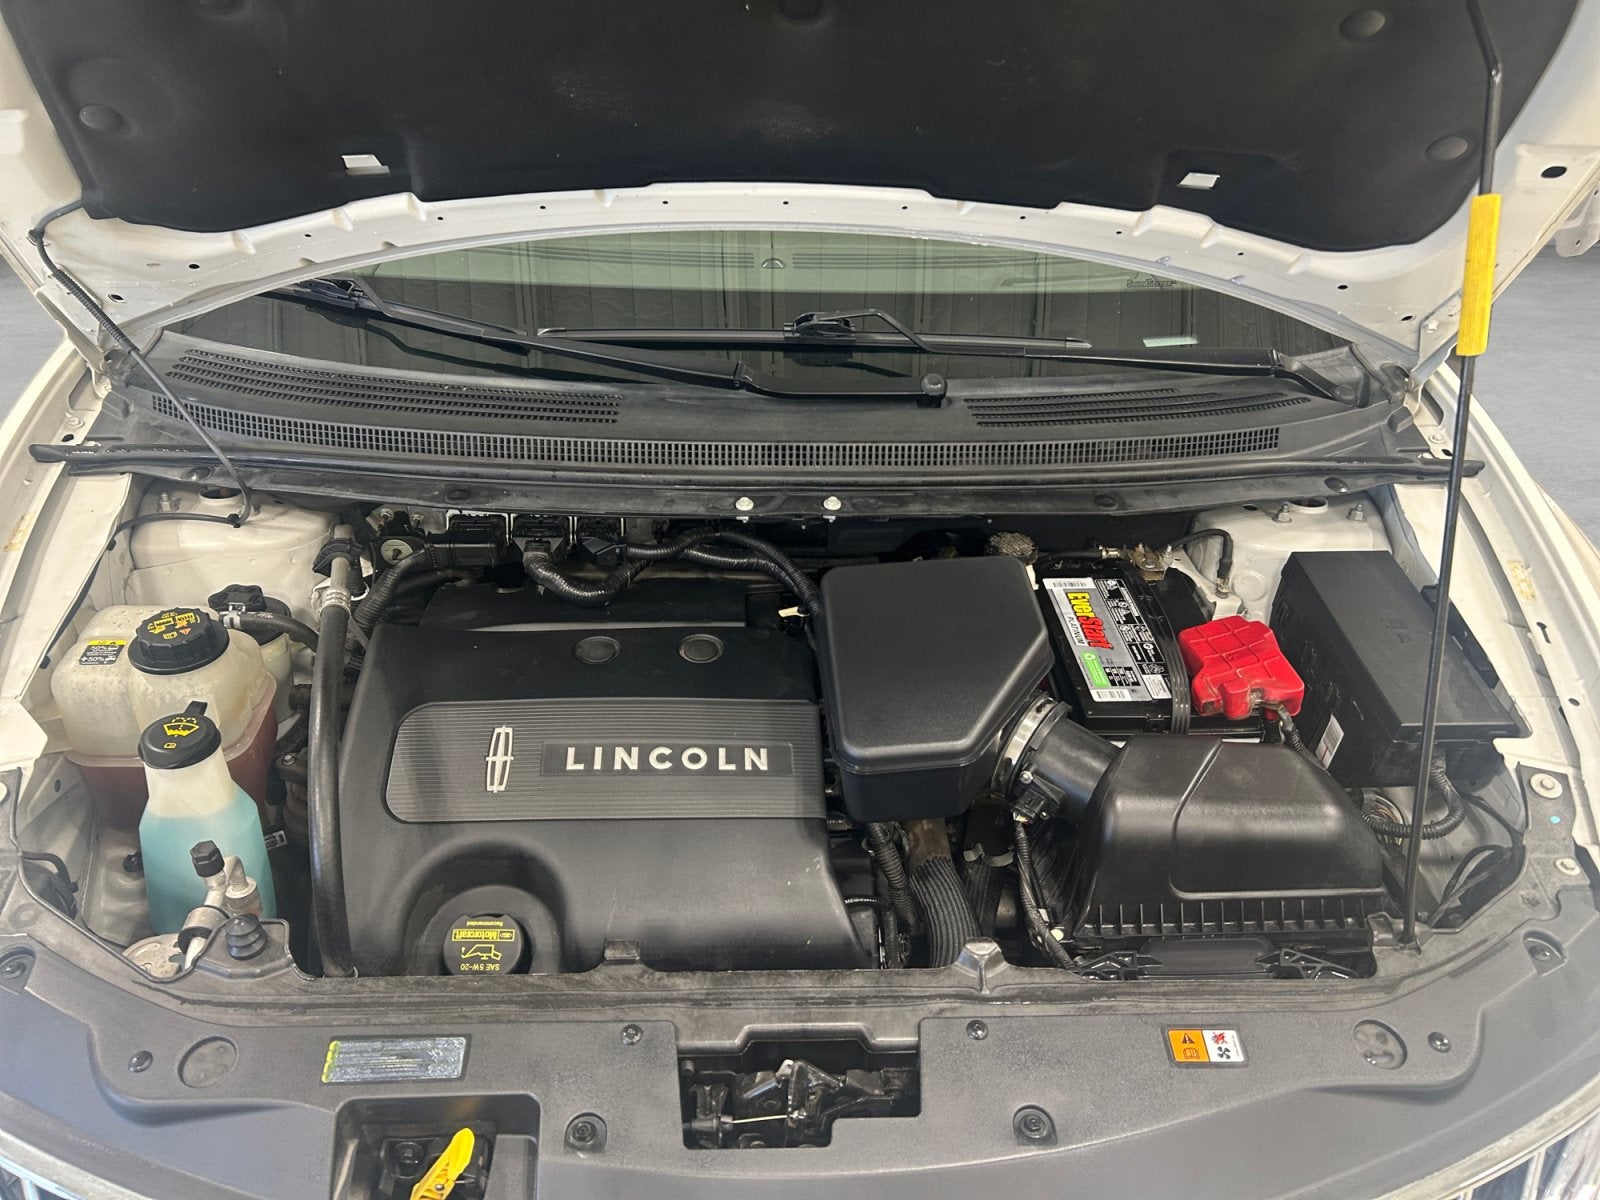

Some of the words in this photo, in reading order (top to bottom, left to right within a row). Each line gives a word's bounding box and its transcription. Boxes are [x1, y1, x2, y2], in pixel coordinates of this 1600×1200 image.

[1066, 591, 1113, 650] EverStart
[1066, 615, 1086, 646] PLATINUM
[566, 746, 769, 771] LINCOLN
[454, 930, 499, 940] Motorcraft
[460, 963, 484, 971] 5W-20
[485, 963, 500, 971] SAE
